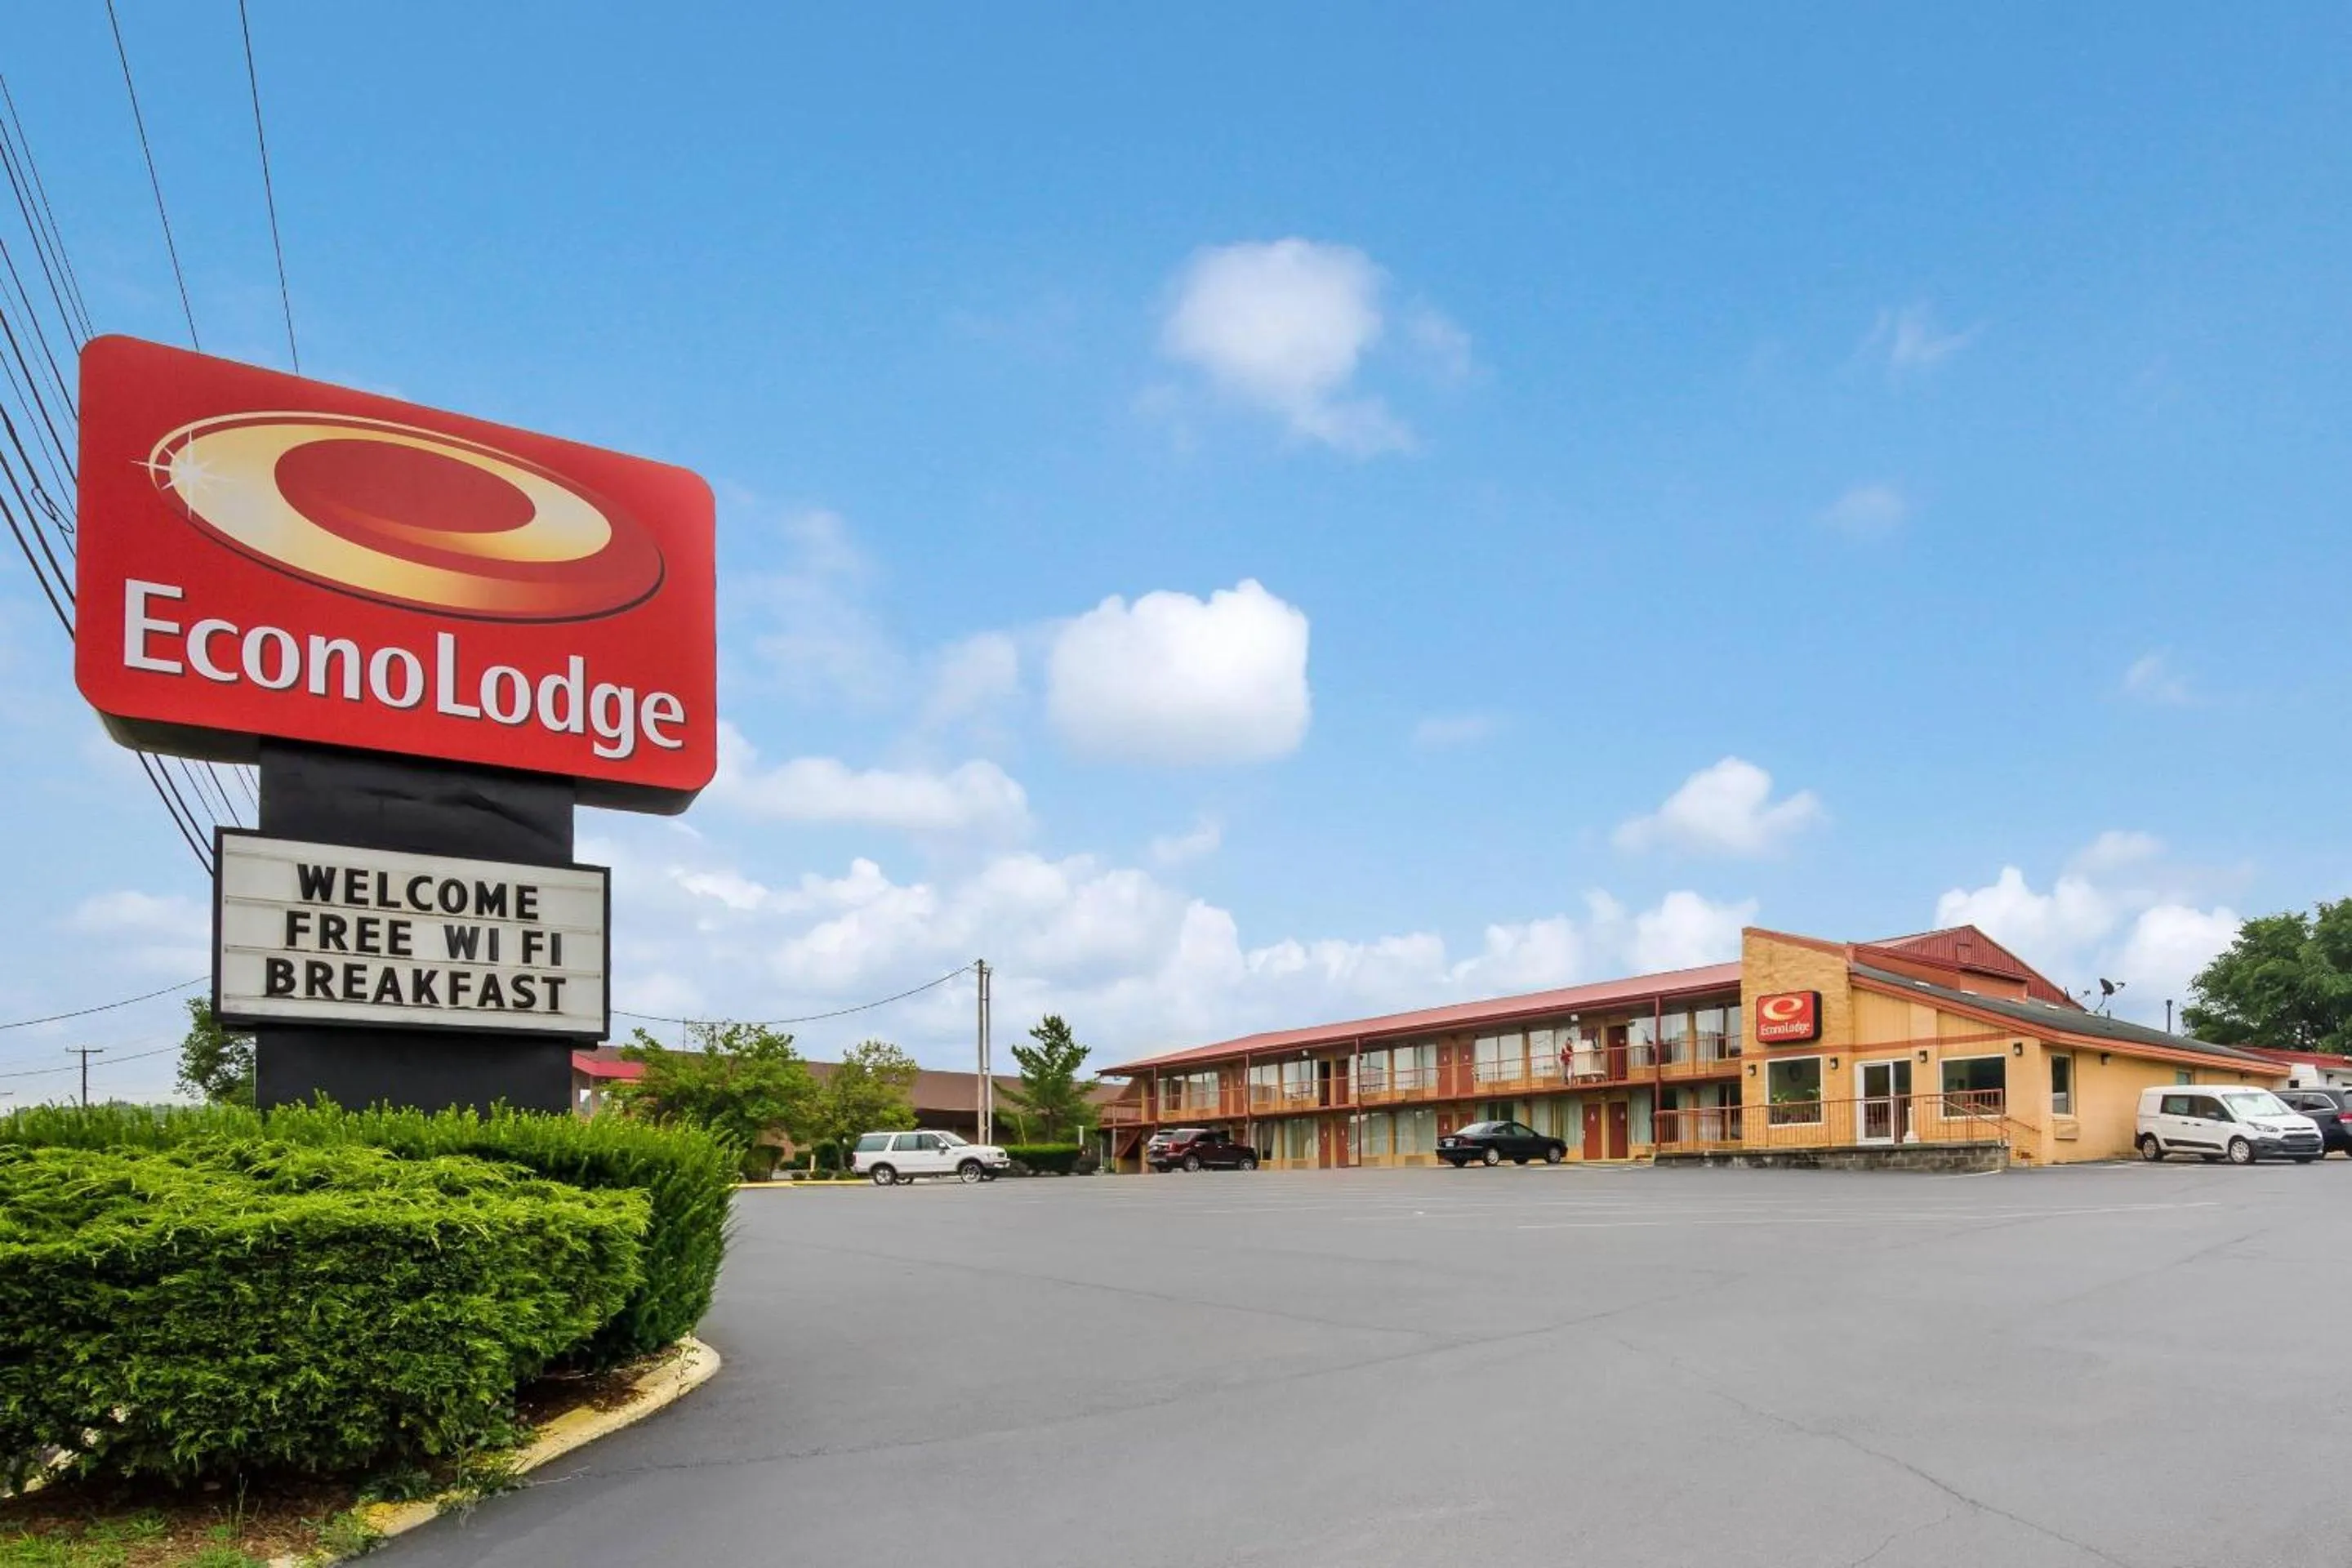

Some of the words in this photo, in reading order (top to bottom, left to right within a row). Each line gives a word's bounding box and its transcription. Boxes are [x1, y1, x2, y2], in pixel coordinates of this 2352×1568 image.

[122, 578, 687, 760] EconoLodge
[297, 863, 539, 920] WELCOME
[285, 911, 412, 956] FREE
[265, 957, 567, 1013] BREAKFAST
